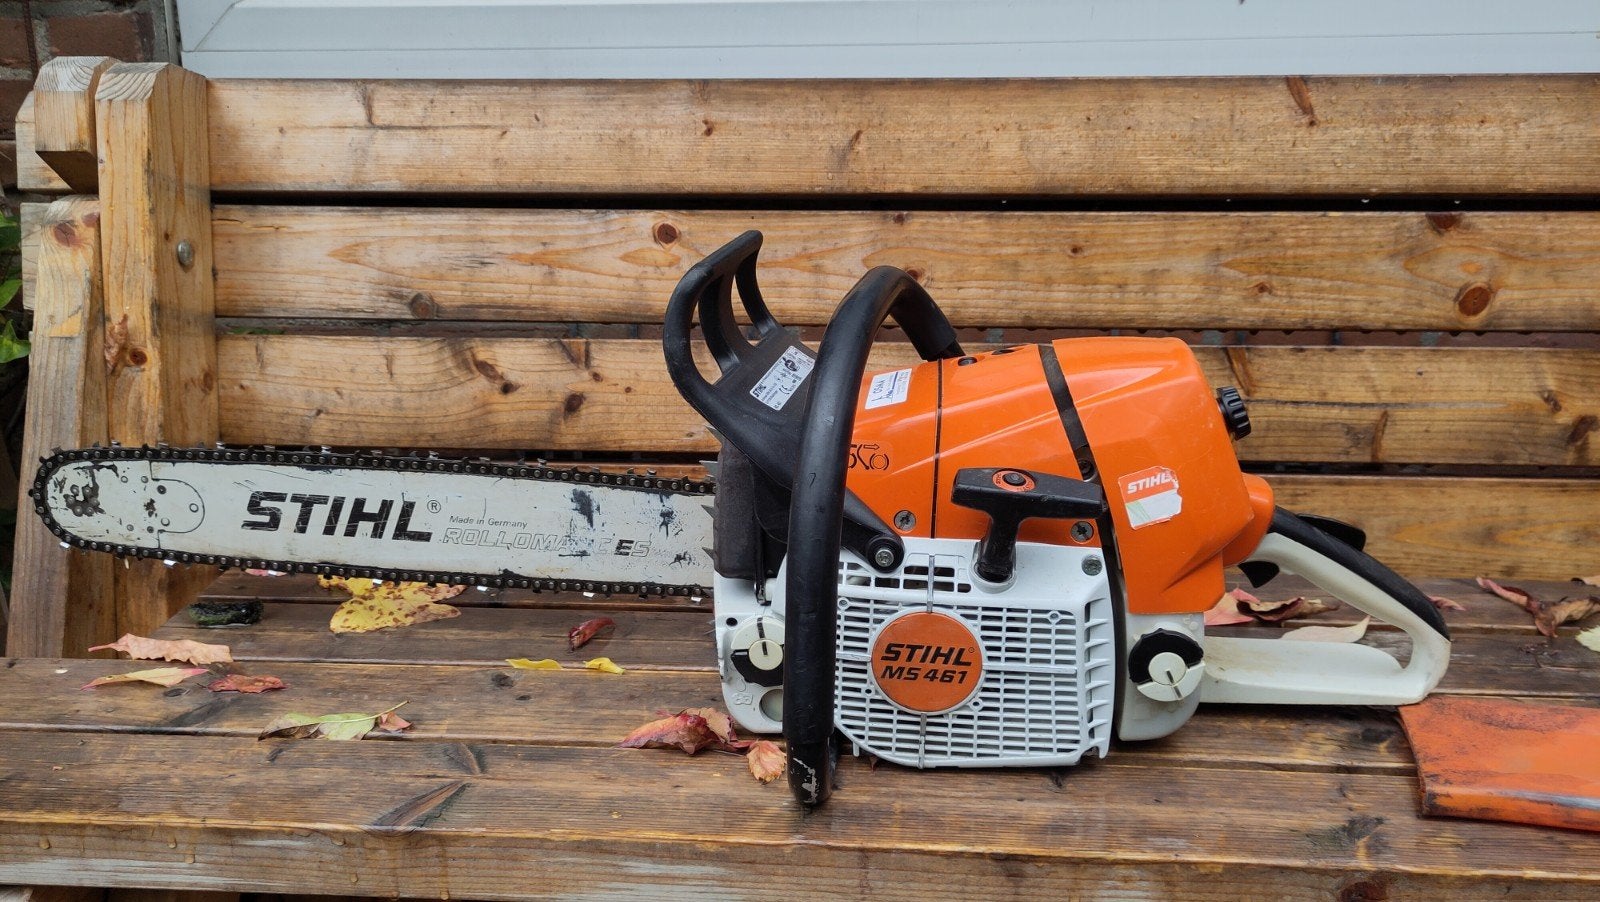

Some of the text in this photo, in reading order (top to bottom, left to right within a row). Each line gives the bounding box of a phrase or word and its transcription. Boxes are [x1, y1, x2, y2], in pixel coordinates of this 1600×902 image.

[1127, 471, 1172, 494] STIHL
[241, 490, 433, 542] STIHL
[449, 515, 528, 530] Made in Germany
[613, 538, 653, 558] ES
[880, 642, 973, 667] STIHL
[880, 665, 968, 684] MS 461
